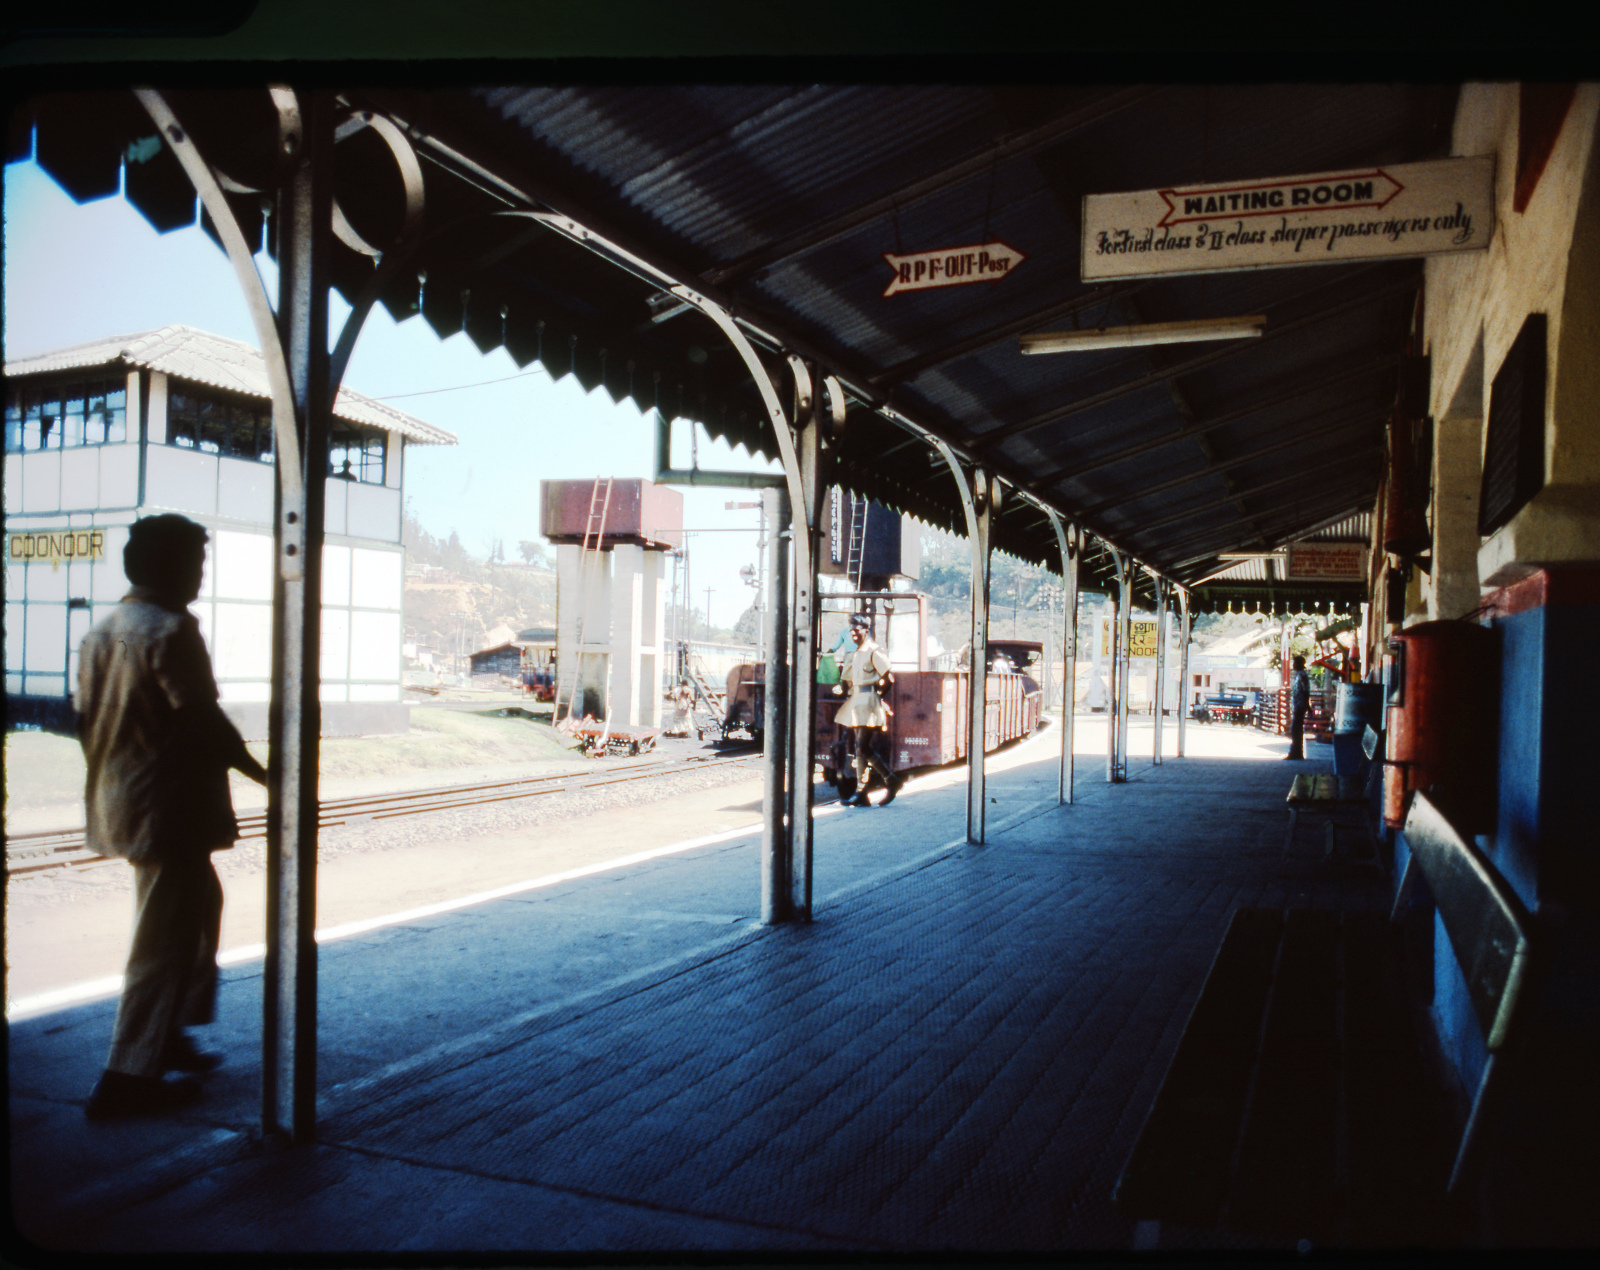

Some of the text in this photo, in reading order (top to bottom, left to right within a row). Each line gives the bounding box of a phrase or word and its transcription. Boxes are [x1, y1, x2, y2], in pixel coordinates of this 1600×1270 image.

[1184, 181, 1373, 215] WAITING ROOM
[1154, 225, 1191, 252] class
[1208, 230, 1225, 252] II
[1225, 220, 1266, 247] class
[1270, 216, 1329, 253] sleeper
[1327, 216, 1430, 251] passengers
[1433, 202, 1475, 245] only
[11, 533, 103, 558] COONOOR
